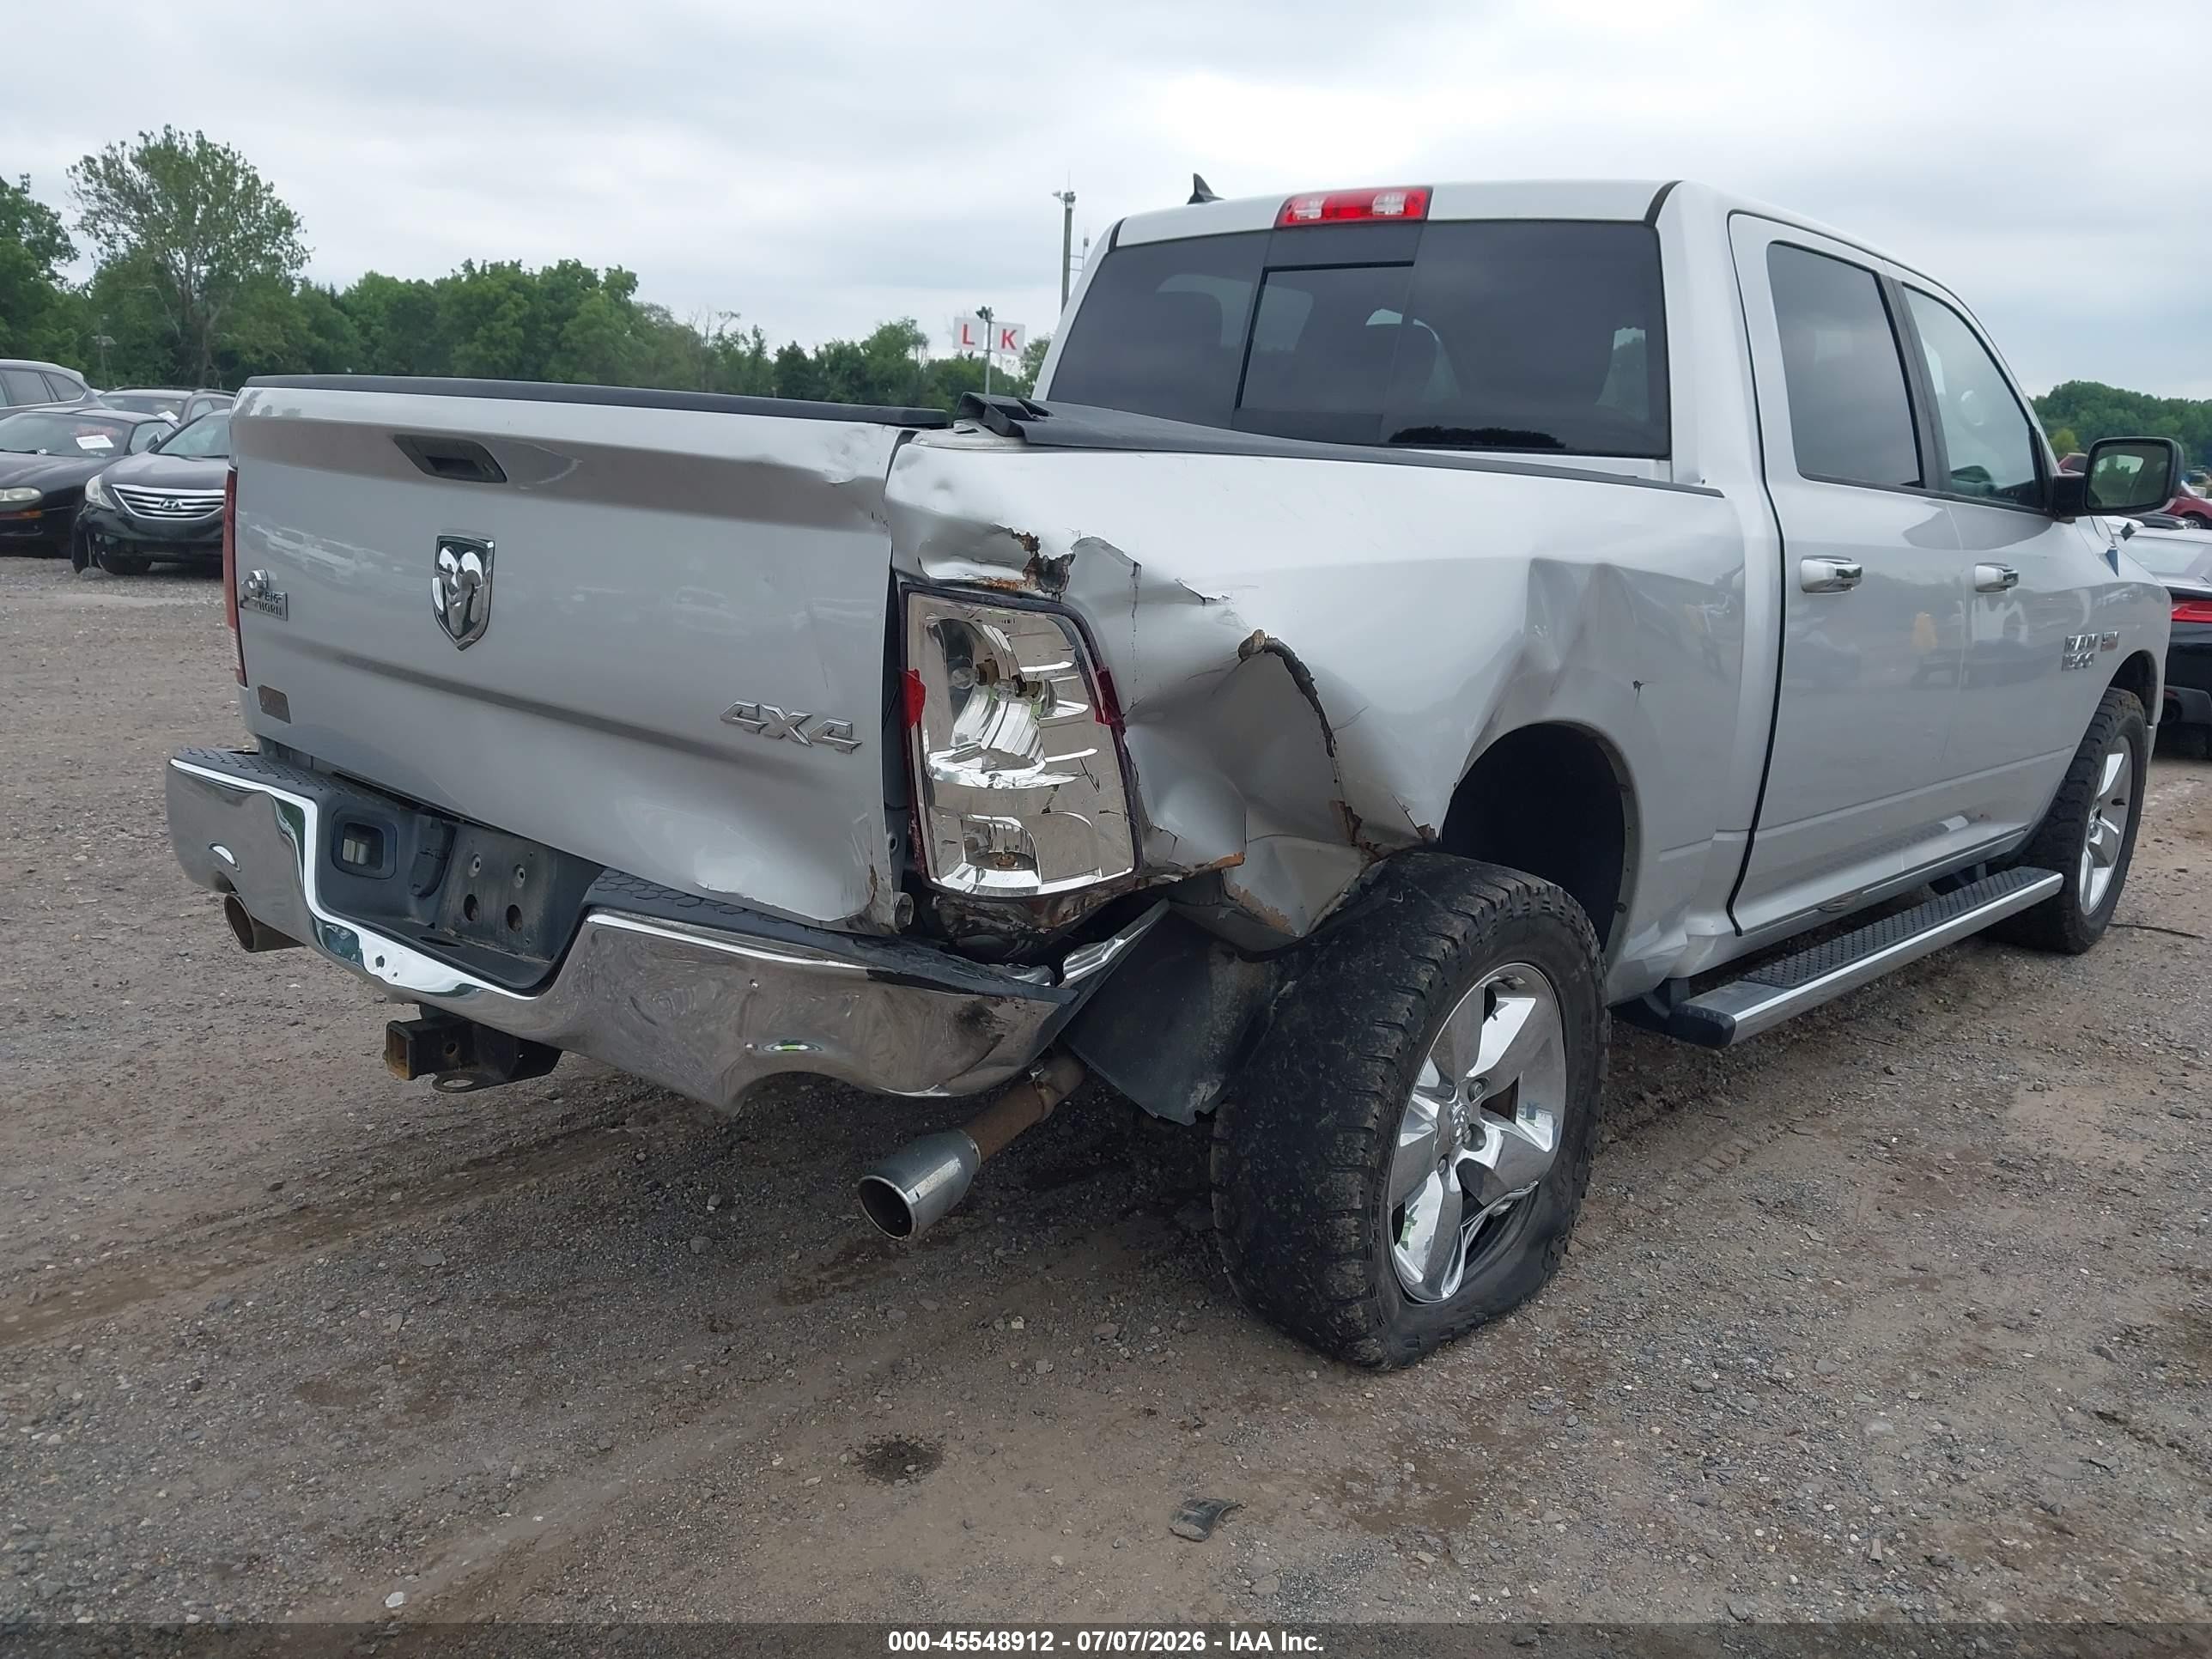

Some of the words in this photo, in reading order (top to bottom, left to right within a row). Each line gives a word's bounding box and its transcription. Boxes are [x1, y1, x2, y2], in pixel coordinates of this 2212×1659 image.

[963, 323, 975, 345] L
[1001, 328, 1017, 350] K
[2064, 633, 2098, 652] RAM
